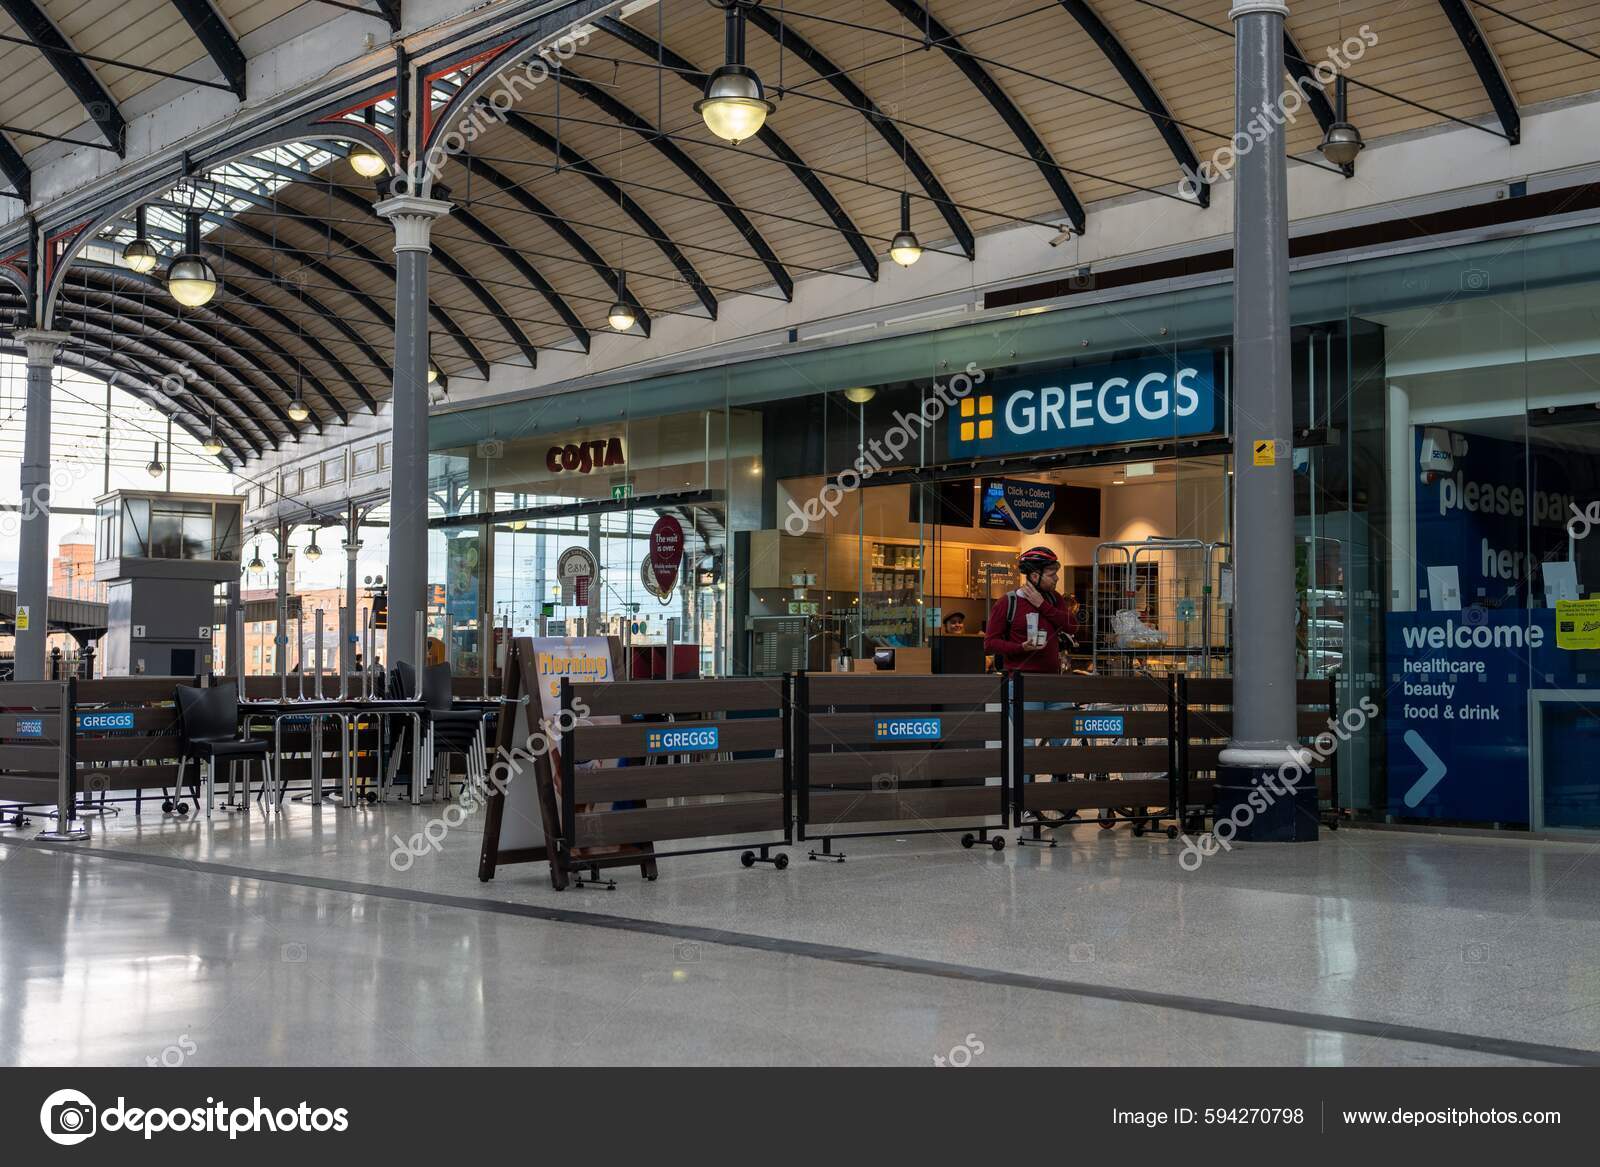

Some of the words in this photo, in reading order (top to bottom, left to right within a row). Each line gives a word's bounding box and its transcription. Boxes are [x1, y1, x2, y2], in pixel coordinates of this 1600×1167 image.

[1005, 367, 1199, 435] GREGGS
[546, 437, 625, 474] COSTA
[1007, 486, 1024, 497] Click
[1029, 488, 1050, 499] Collect
[1440, 470, 1525, 516] please
[1014, 498, 1045, 509] collection
[1021, 510, 1038, 520] point
[136, 627, 143, 636] 1
[201, 629, 208, 638] 2
[1402, 619, 1544, 648] welcome
[539, 651, 608, 679] Morning
[1403, 658, 1486, 673] healthcare
[1403, 681, 1455, 699] beauty
[1403, 704, 1438, 719] food
[1443, 704, 1454, 719] &
[1459, 704, 1500, 720] drink
[83, 715, 132, 728] GREGGS
[889, 722, 938, 736] GREGGS
[1084, 719, 1122, 732] GREGGS
[663, 731, 715, 747] GREGGS
